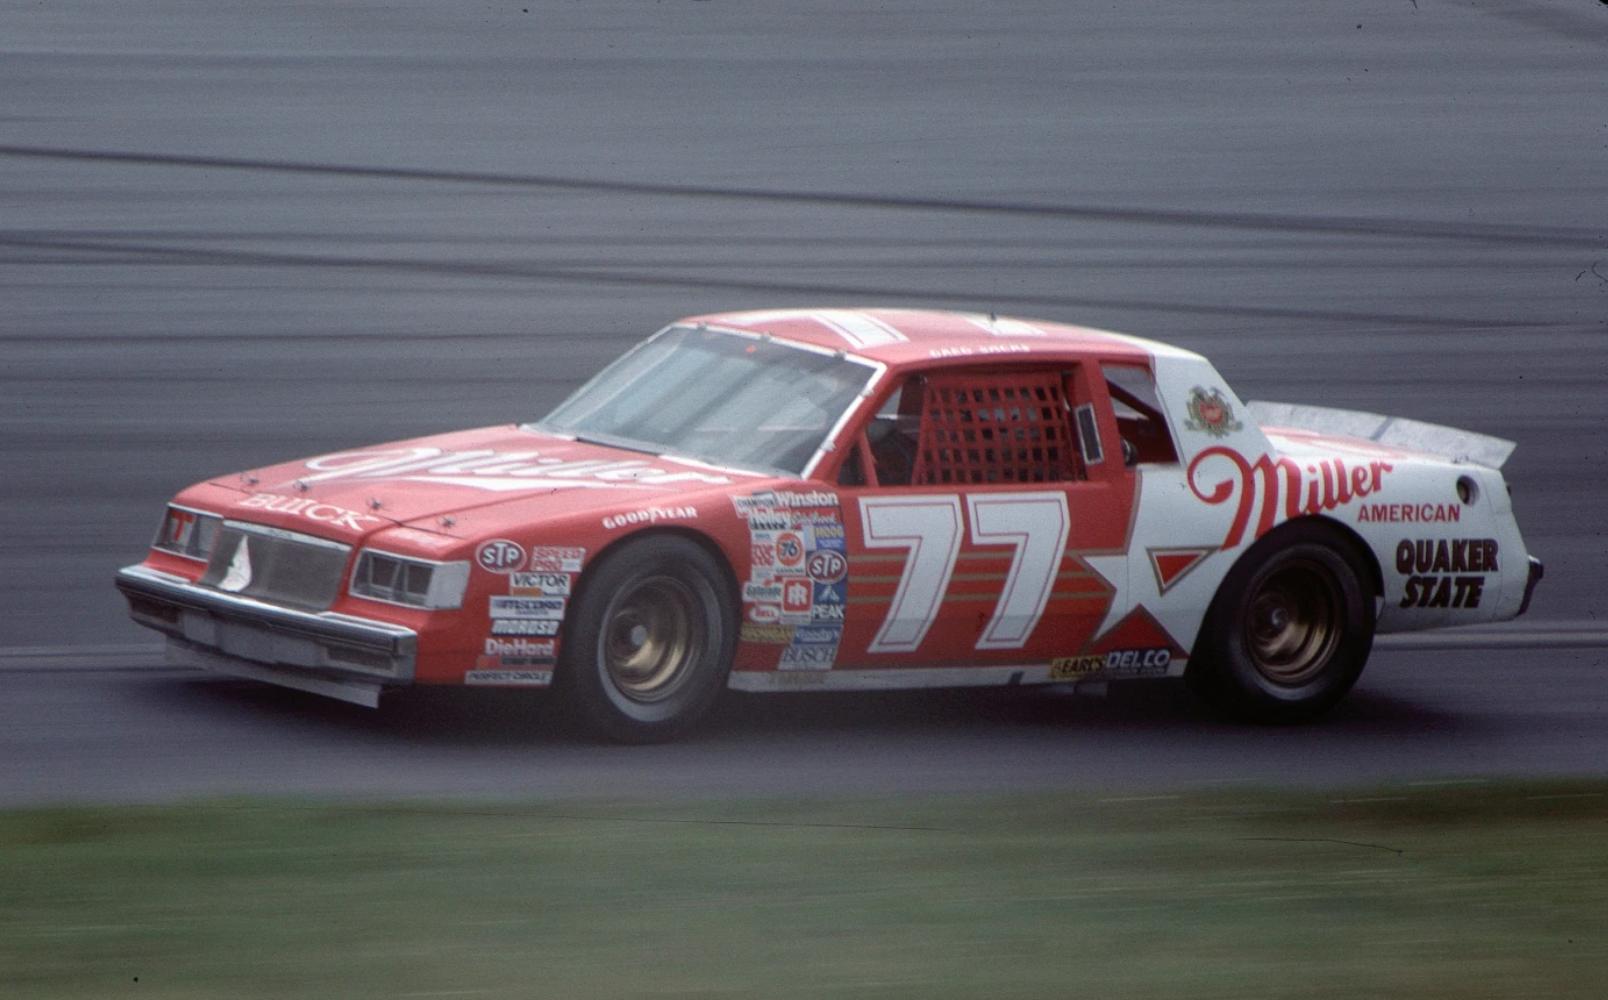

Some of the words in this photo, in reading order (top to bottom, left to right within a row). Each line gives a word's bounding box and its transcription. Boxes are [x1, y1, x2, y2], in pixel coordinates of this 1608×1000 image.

[777, 490, 839, 507] Winston
[1187, 446, 1393, 550] Miller
[239, 494, 380, 531] BUICK
[602, 506, 698, 529] GOODYEAR
[1357, 504, 1460, 522] AMERICAN
[482, 543, 519, 567] STP
[780, 541, 799, 560] 76
[1395, 538, 1499, 575] QUAKER
[811, 554, 842, 578] STP
[858, 491, 1071, 653] 77
[513, 574, 567, 587] VICTOR
[1400, 576, 1485, 609] STATE
[484, 638, 555, 656] DieHard
[1106, 649, 1171, 668] DELCO
